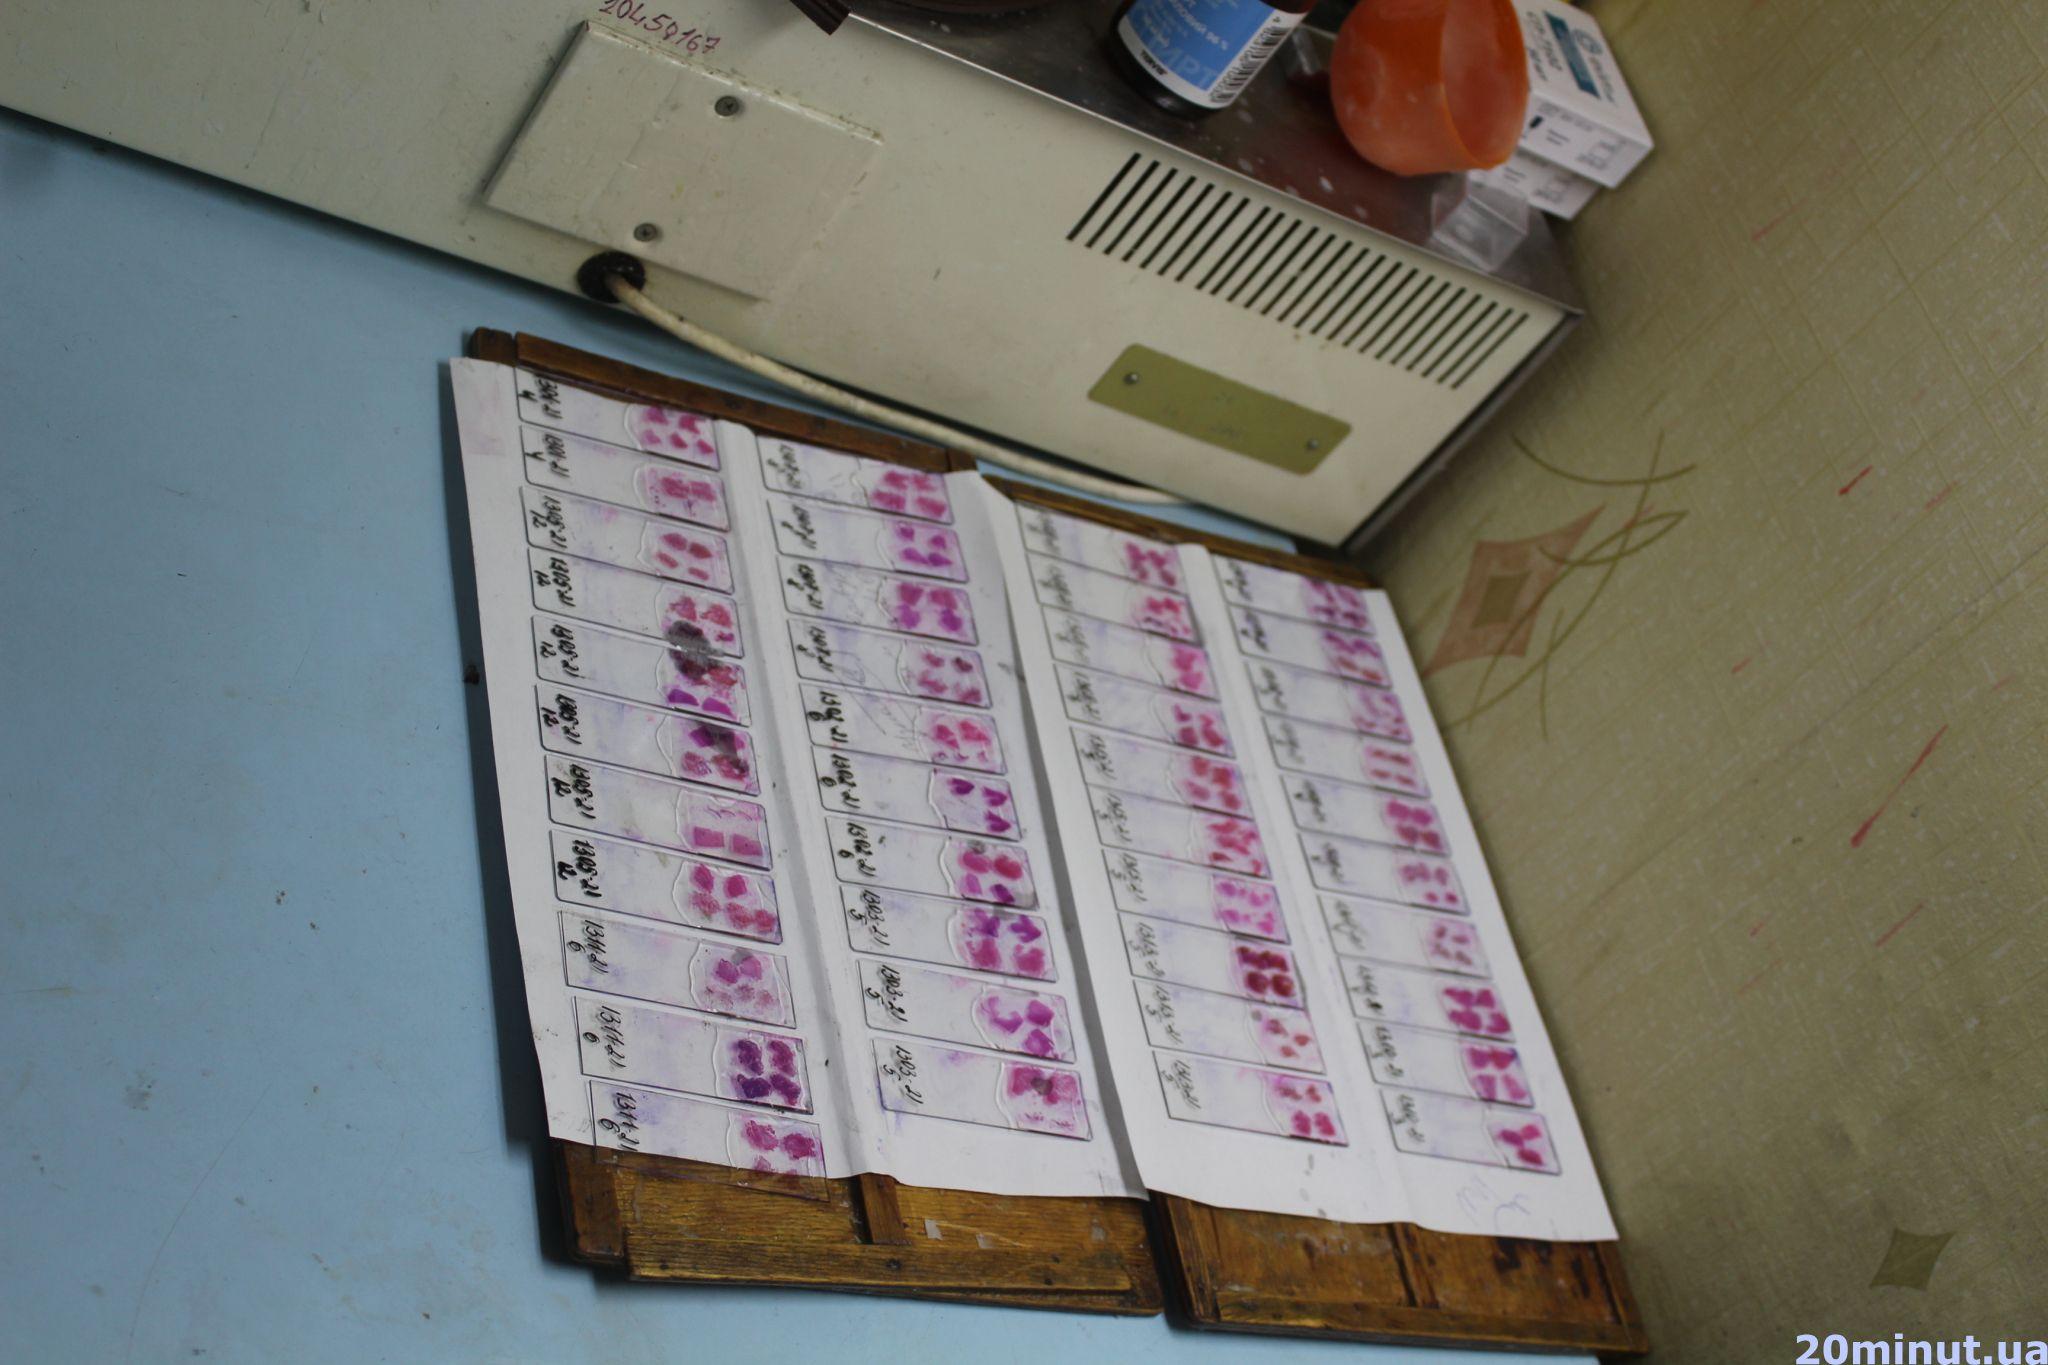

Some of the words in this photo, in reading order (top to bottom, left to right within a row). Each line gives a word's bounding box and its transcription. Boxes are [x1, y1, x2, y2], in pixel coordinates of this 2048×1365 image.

[848, 908, 867, 925] 5
[566, 940, 586, 952] 6
[864, 987, 887, 1006] 5
[582, 1031, 600, 1043] 6
[882, 1064, 901, 1081] 5
[599, 1117, 620, 1133] 6
